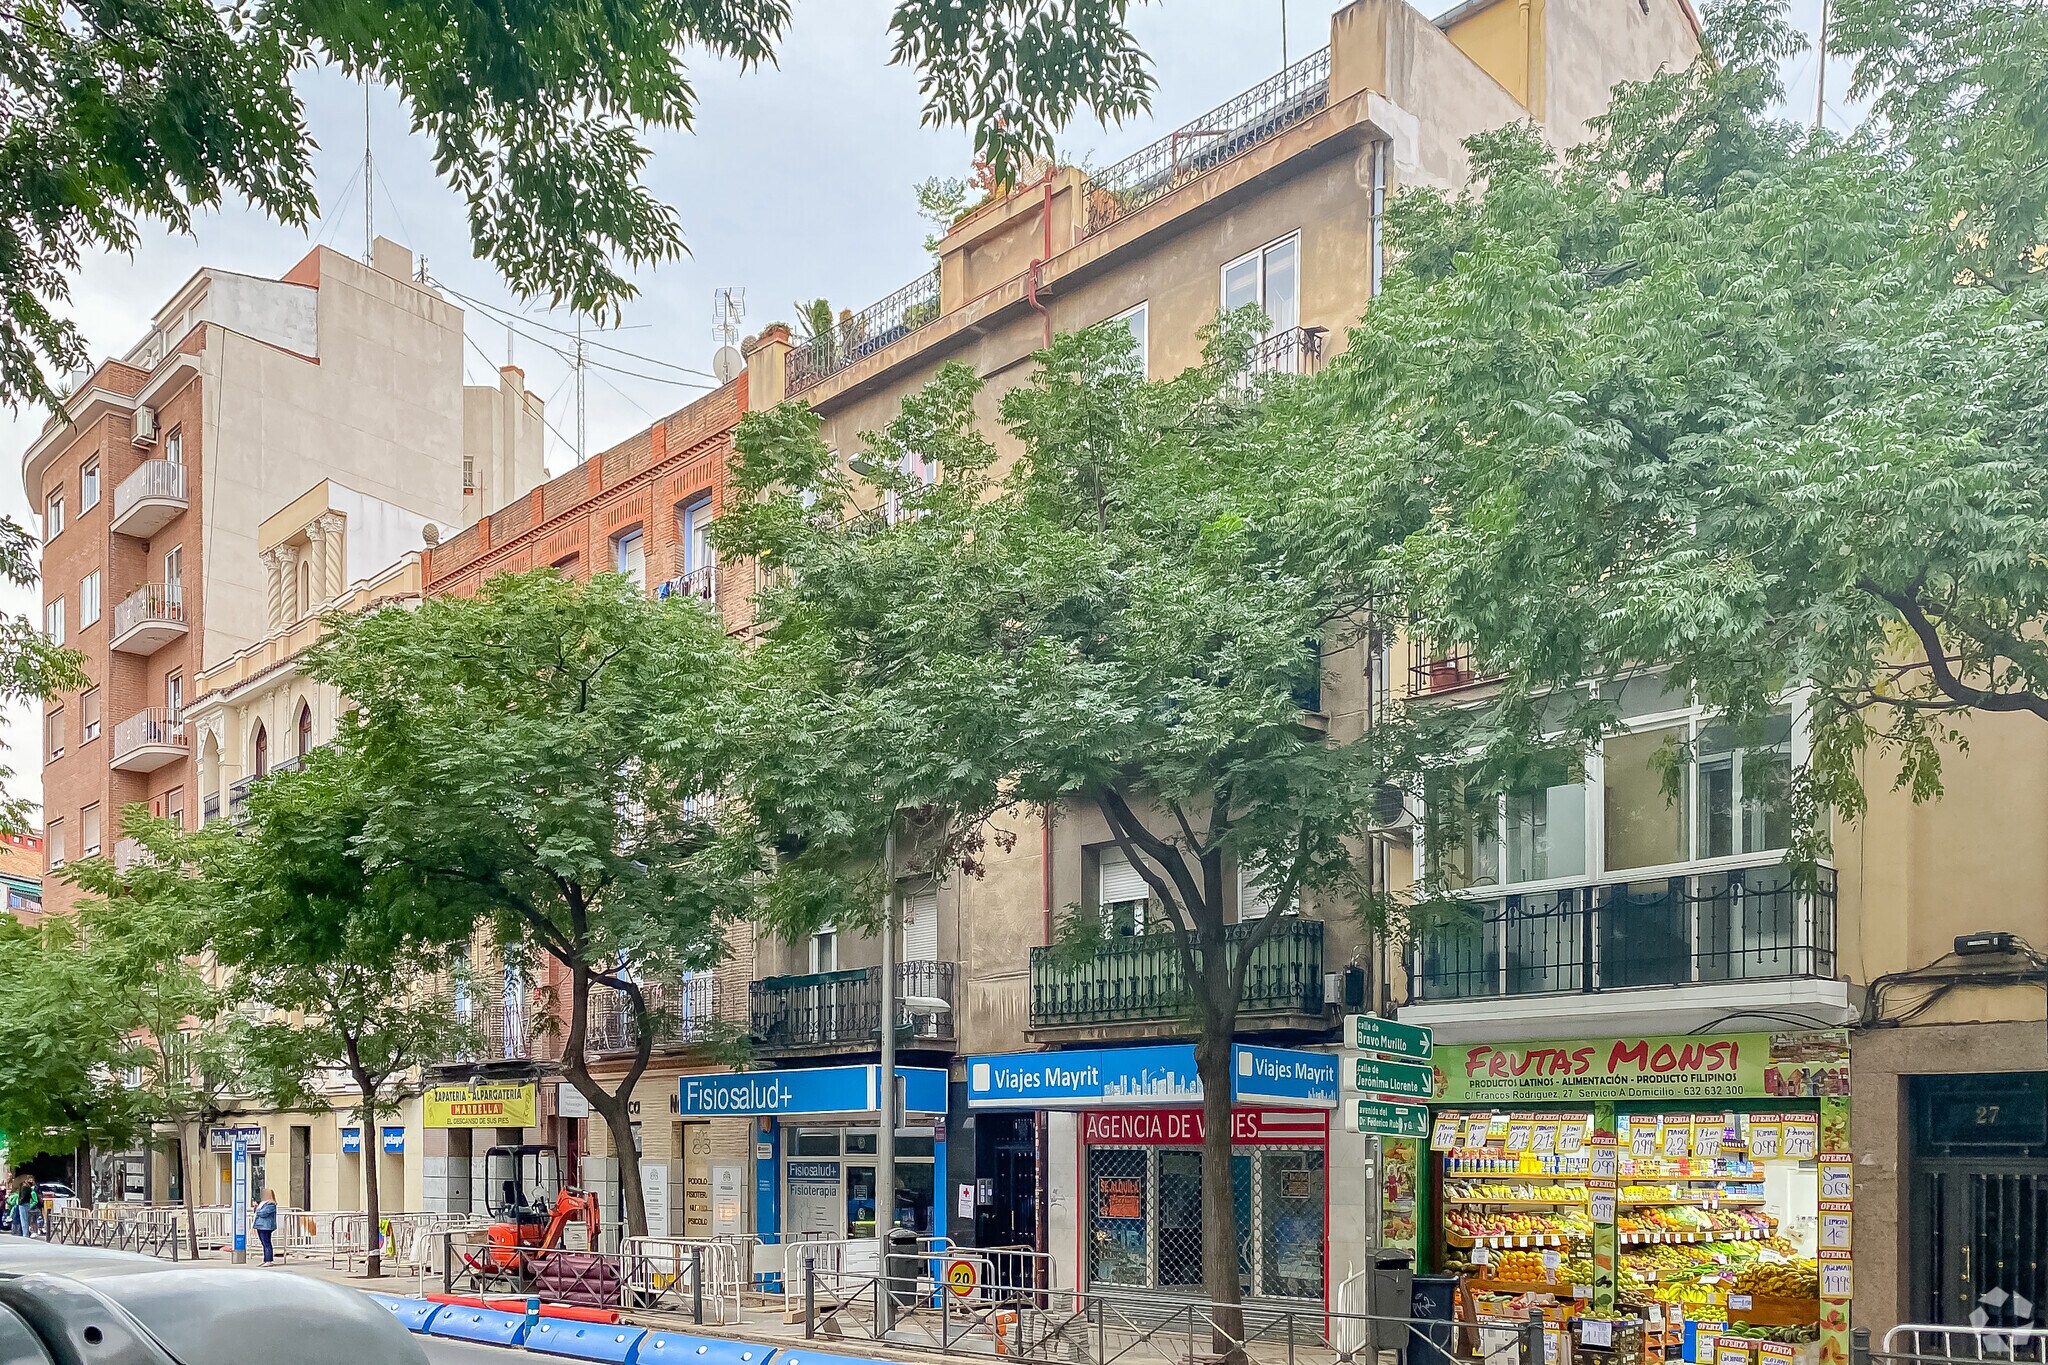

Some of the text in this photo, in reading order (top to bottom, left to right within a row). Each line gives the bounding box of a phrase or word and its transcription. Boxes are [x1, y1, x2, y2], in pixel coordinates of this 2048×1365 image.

[1358, 1021, 1379, 1032] calle de
[1358, 1032, 1407, 1051] Bravo Murillo
[1255, 1058, 1334, 1085] Viajes Mayrit
[1357, 1064, 1379, 1074] calle de
[995, 1065, 1099, 1093] Viajes Mayrit
[1357, 1073, 1418, 1092] Jerónima Llorente
[1469, 1080, 1517, 1088] PRODUCTOS
[1519, 1078, 1554, 1087] LATINOS
[1562, 1074, 1628, 1086] ALIMENTACIÓN
[1637, 1074, 1688, 1084] PRODUCTO
[1691, 1073, 1737, 1083] FILIPINOS
[435, 1091, 466, 1102] ZAPATERIA
[472, 1089, 522, 1100] ALPARGATERIA
[687, 1078, 793, 1110] Fisiosalud+
[1563, 1089, 1573, 1098] 27
[1579, 1088, 1616, 1098] Servicio
[1619, 1088, 1627, 1097] A
[1628, 1087, 1675, 1096] Domicilio
[1683, 1086, 1701, 1095] 632
[1704, 1086, 1722, 1095] 632
[1726, 1085, 1744, 1095] 300
[454, 1104, 499, 1114] MARBELLA
[1360, 1106, 1379, 1115] avenida
[1379, 1107, 1388, 1116] del
[1975, 1106, 2000, 1124] 27
[1087, 1115, 1162, 1138] AGENCIA
[1168, 1115, 1191, 1138] DE
[789, 1163, 837, 1177] Fisiosalud+
[686, 1191, 708, 1199] FISIOTER
[790, 1184, 838, 1198] Fisioterapia
[954, 1273, 970, 1284] 20
[1697, 1323, 1723, 1331] OFERTA
[1720, 1338, 1748, 1349] OFERTA
[1763, 1343, 1793, 1355] OFERTA
